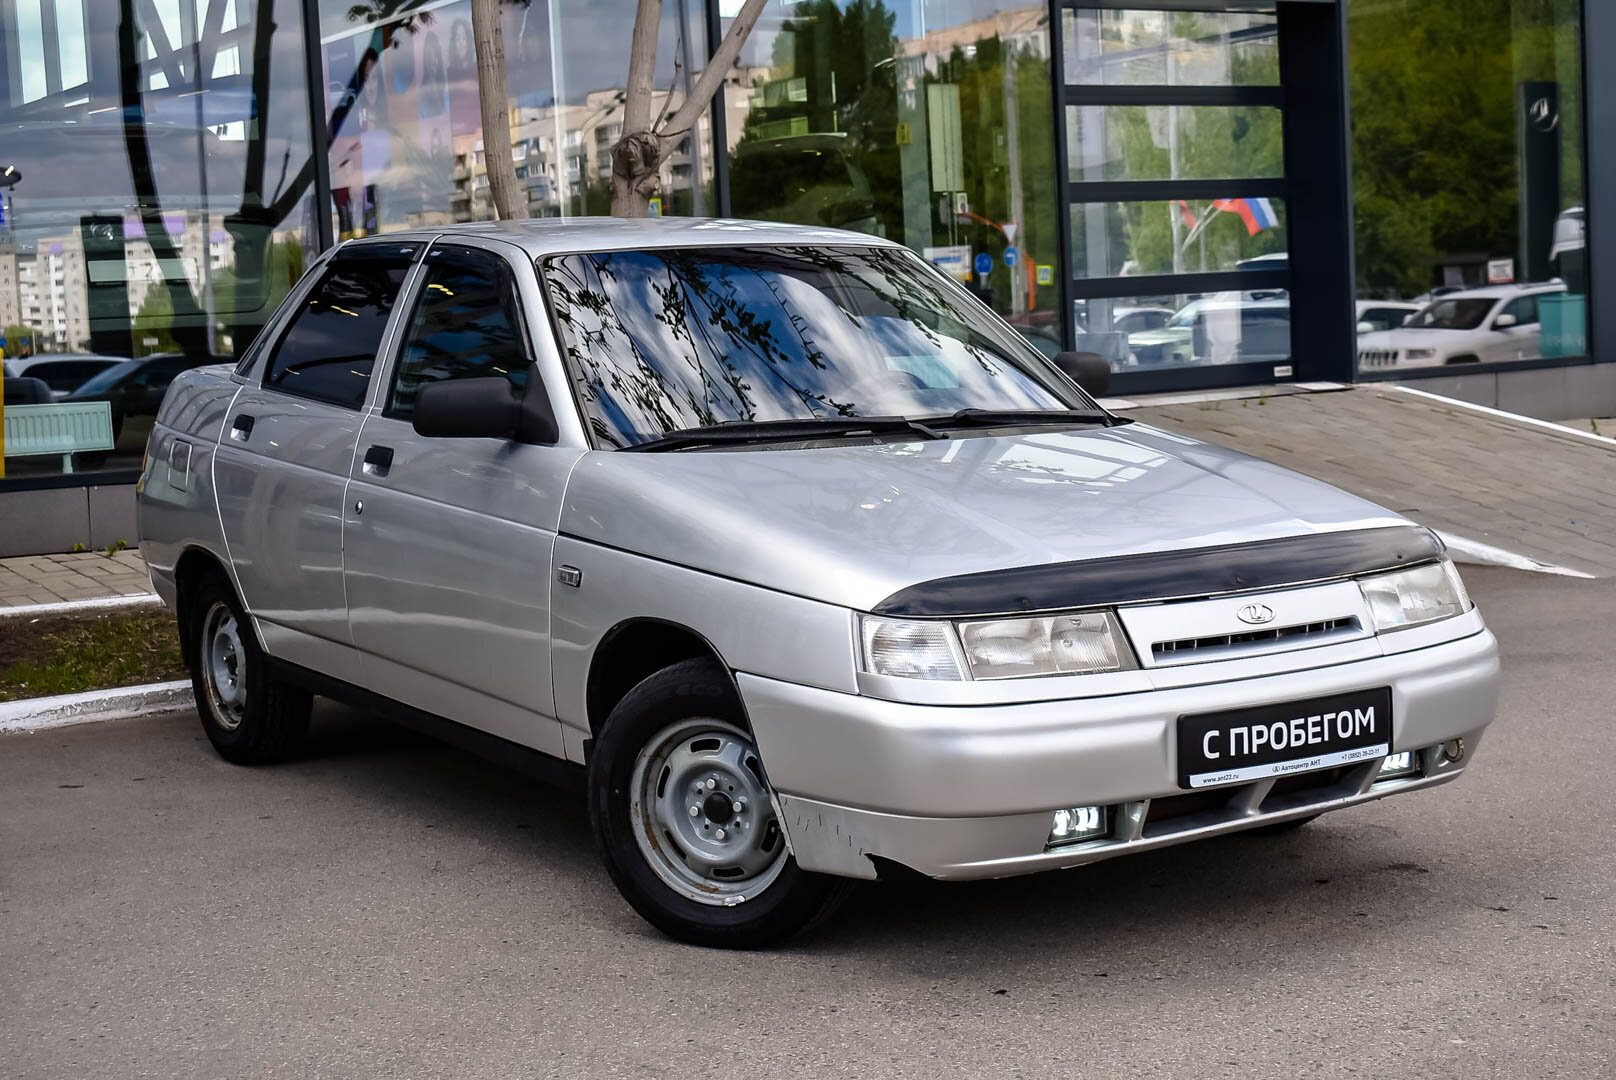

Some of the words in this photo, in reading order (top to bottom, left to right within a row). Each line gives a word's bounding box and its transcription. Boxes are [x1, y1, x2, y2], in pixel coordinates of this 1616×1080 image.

[1203, 730, 1220, 760] С
[1229, 706, 1376, 757] ПРОБЕГОМ
[1281, 762, 1310, 771] Автоцентр
[1310, 758, 1321, 767] АНТ
[1202, 774, 1240, 784] www.ant22.ru
